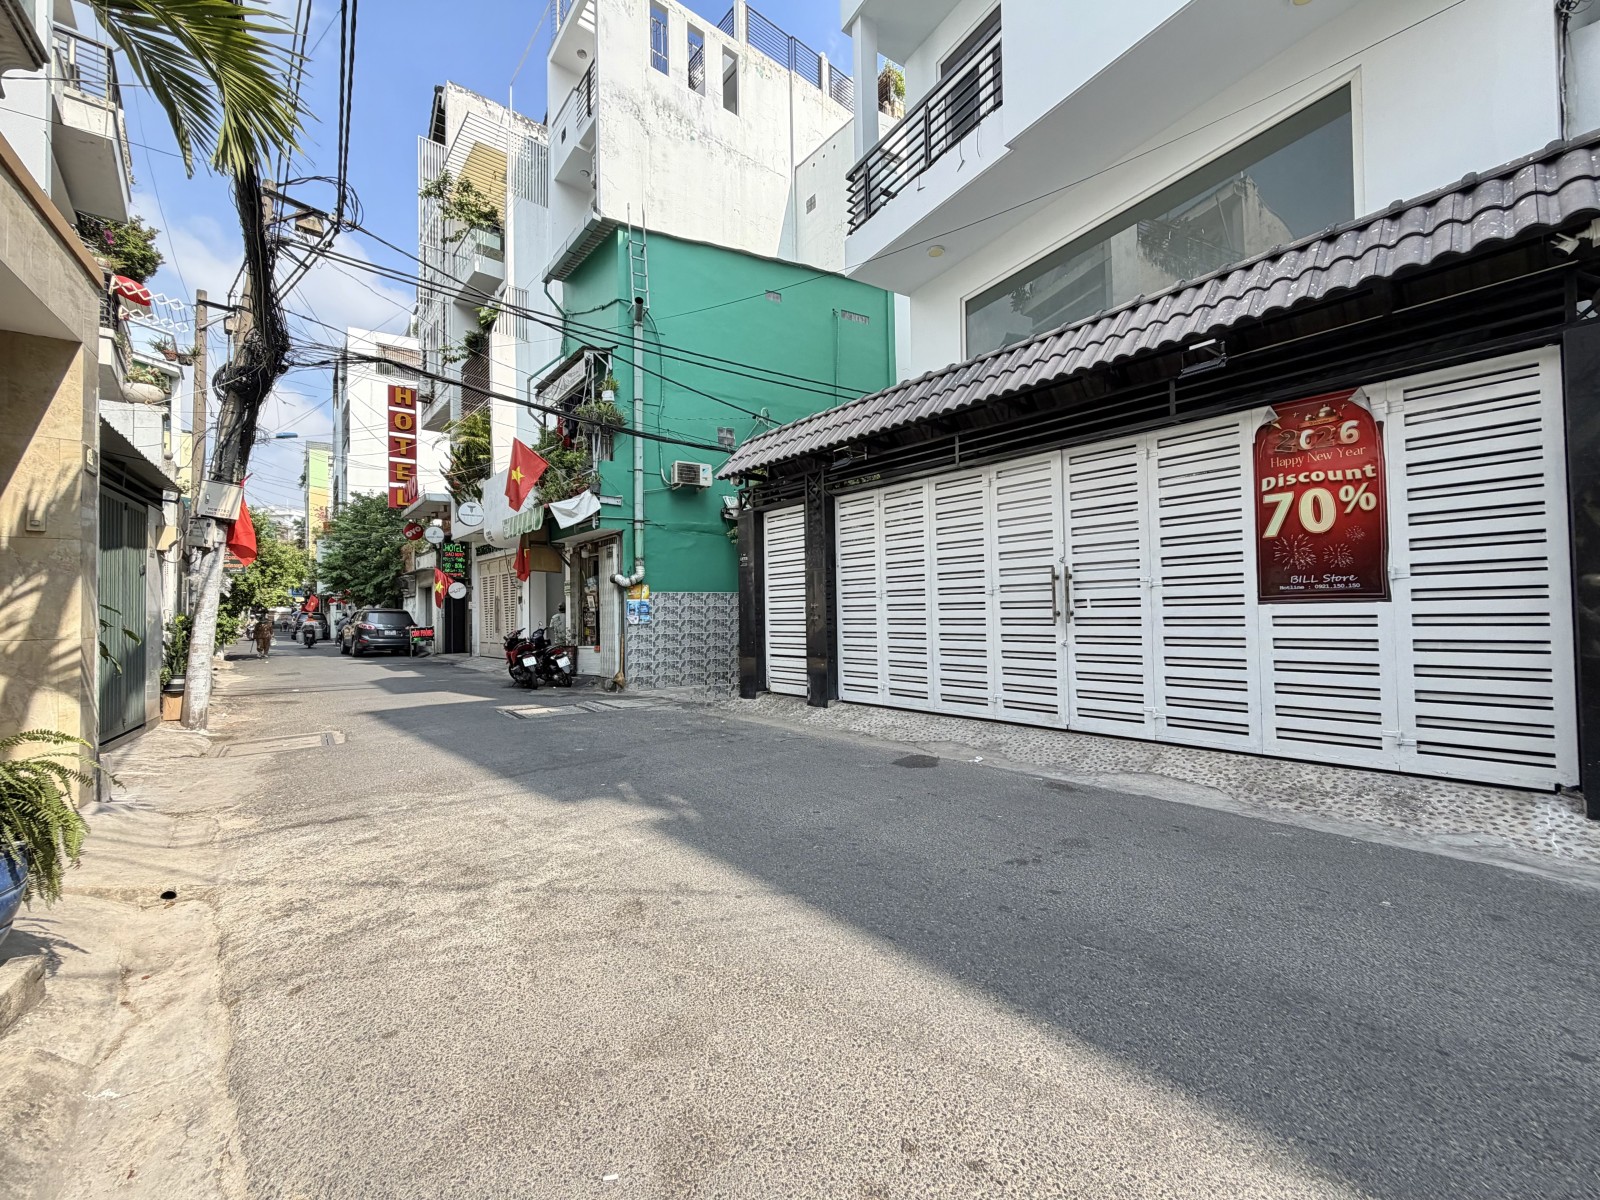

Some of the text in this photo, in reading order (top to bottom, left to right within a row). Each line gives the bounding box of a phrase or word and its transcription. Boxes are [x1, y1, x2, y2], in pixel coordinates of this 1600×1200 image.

[394, 387, 413, 507] HOTEL
[1274, 420, 1361, 454] 2026
[1270, 446, 1366, 469] Happy New Year
[1261, 463, 1377, 492] Discount
[1262, 482, 1378, 539] 70%
[405, 525, 422, 538] OYO
[1290, 573, 1359, 584] BILL Store
